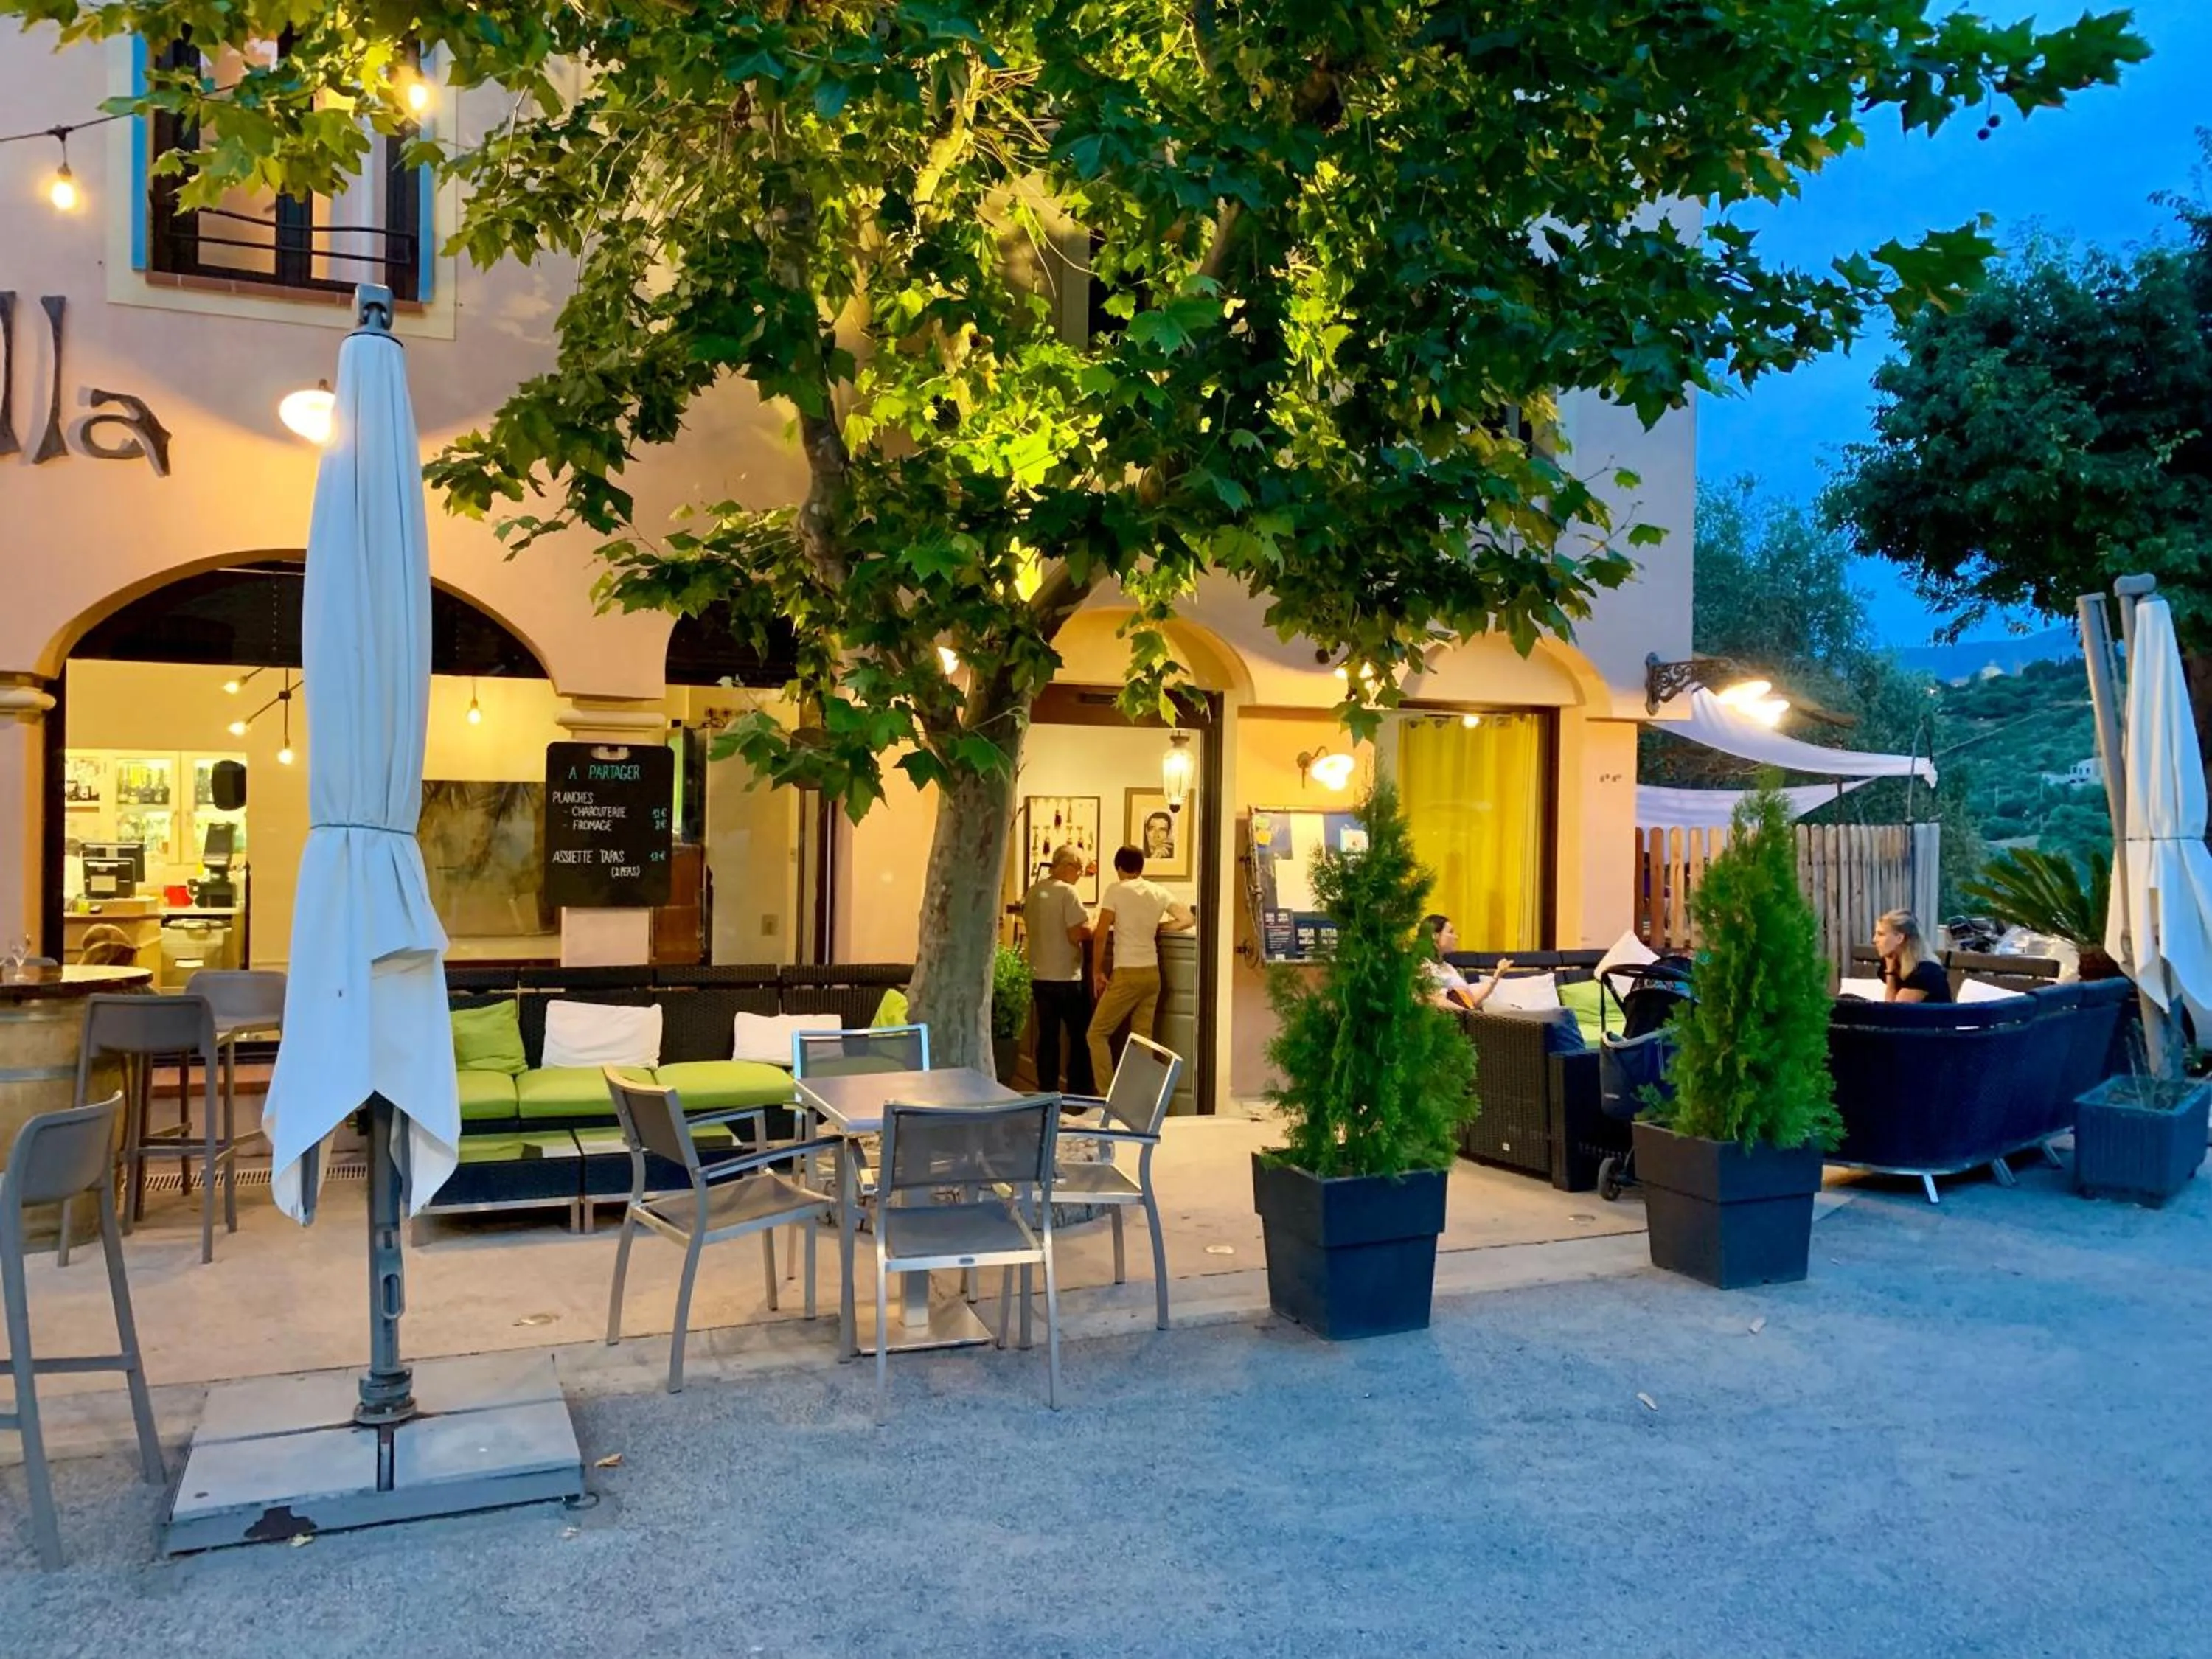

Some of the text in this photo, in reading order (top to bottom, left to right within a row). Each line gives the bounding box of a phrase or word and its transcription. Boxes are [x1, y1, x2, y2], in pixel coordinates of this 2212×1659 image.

[568, 765, 640, 780] A PARTAGER
[552, 791, 594, 804] PLANCHES
[571, 806, 626, 818] CHARCUTERIE
[572, 819, 613, 832] FROMAGE
[552, 850, 593, 863] ASSIETTE
[600, 850, 625, 863] TAPAS
